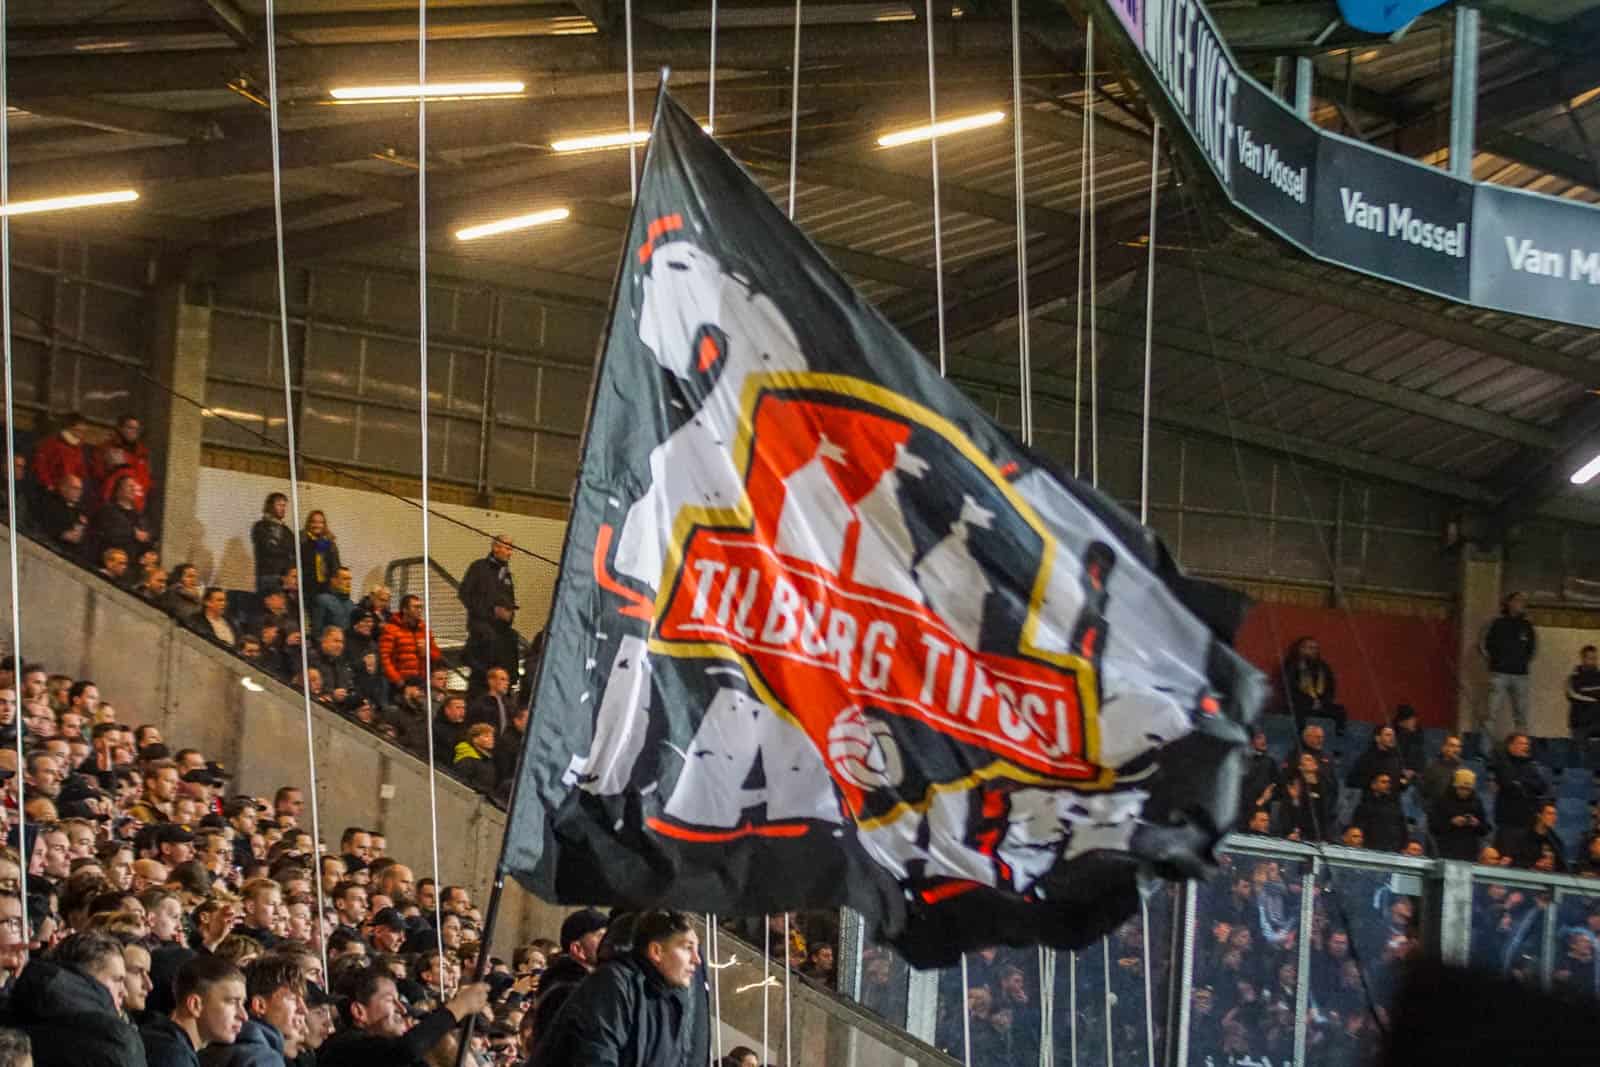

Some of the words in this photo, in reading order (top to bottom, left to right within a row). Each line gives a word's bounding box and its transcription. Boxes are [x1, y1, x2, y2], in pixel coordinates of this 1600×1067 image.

[1238, 126, 1262, 174] Van
[1264, 144, 1307, 203] Mossel
[1340, 187, 1385, 232] Van
[1388, 203, 1466, 257] Mossel
[1504, 236, 1563, 277] Van
[690, 559, 897, 691] TILBURG
